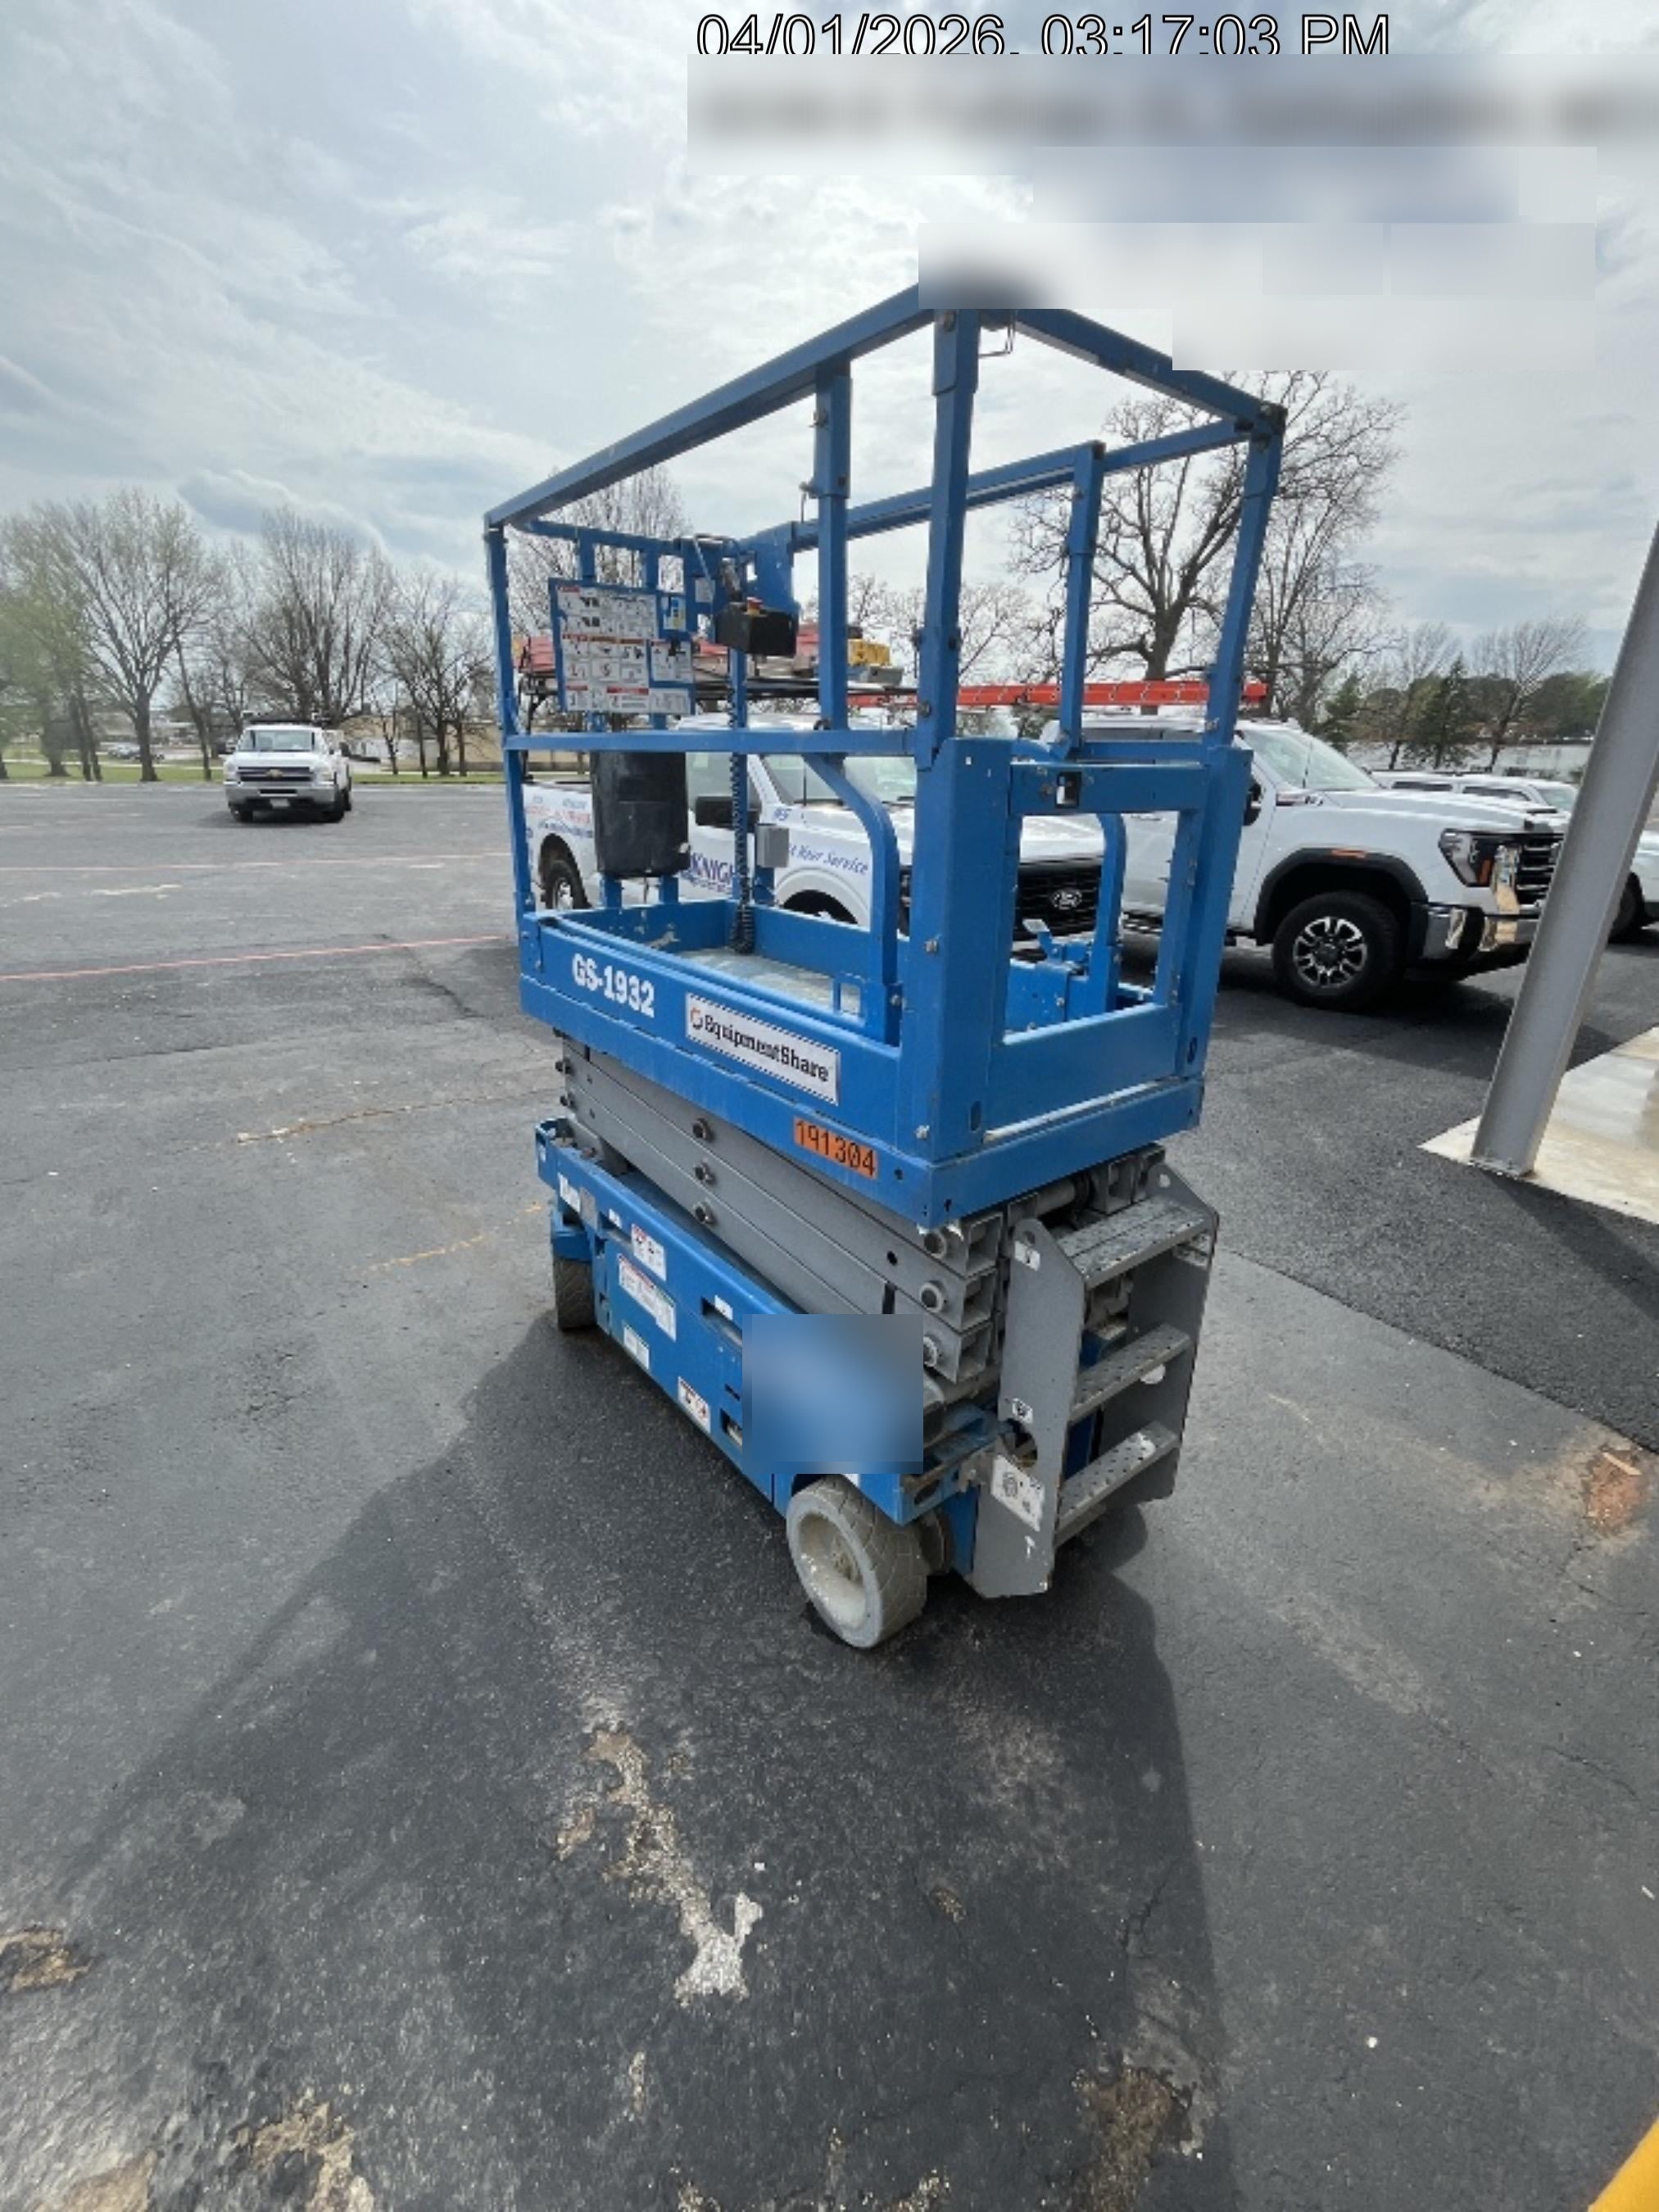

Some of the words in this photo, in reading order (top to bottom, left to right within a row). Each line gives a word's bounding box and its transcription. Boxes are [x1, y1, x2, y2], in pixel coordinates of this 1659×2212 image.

[823, 852, 868, 875] Service
[572, 953, 655, 1019] GS-1932
[704, 1013, 830, 1083] EquipmentShare
[796, 1120, 876, 1177] 191304
